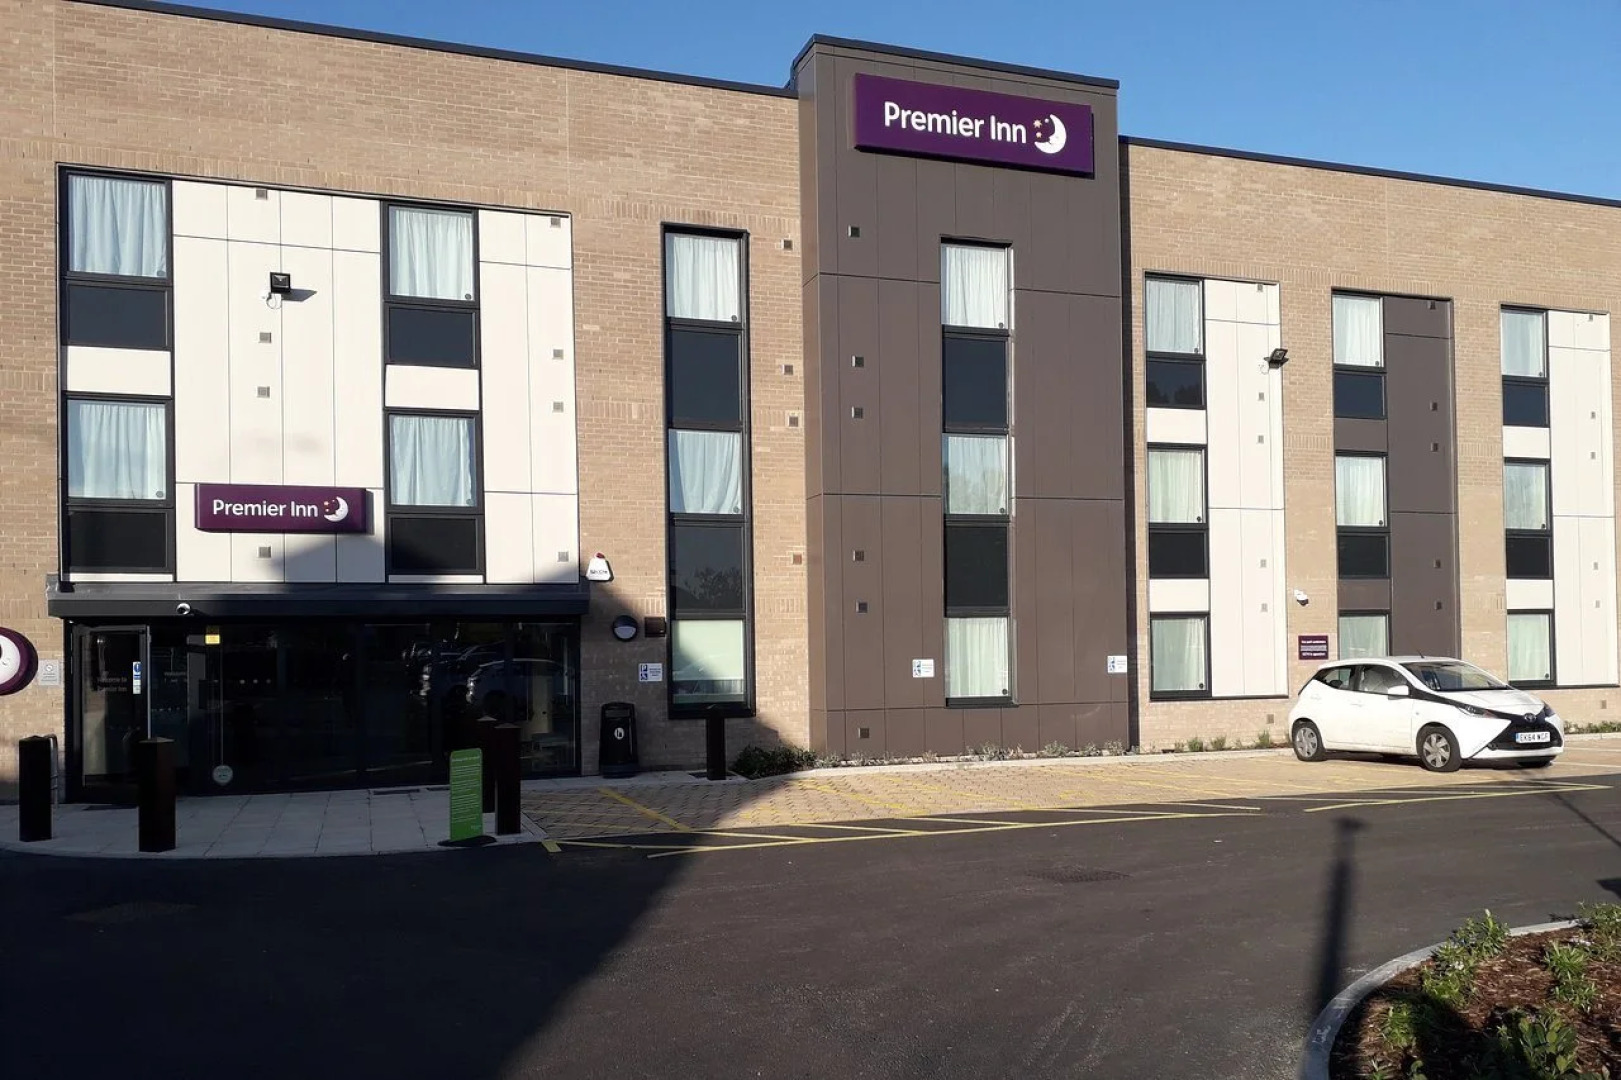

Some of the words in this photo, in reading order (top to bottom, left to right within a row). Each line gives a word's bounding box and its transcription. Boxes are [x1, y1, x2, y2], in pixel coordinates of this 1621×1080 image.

[884, 101, 984, 138] Premier
[990, 114, 1027, 144] Inn
[213, 499, 287, 516] Premier
[290, 501, 319, 517] Inn
